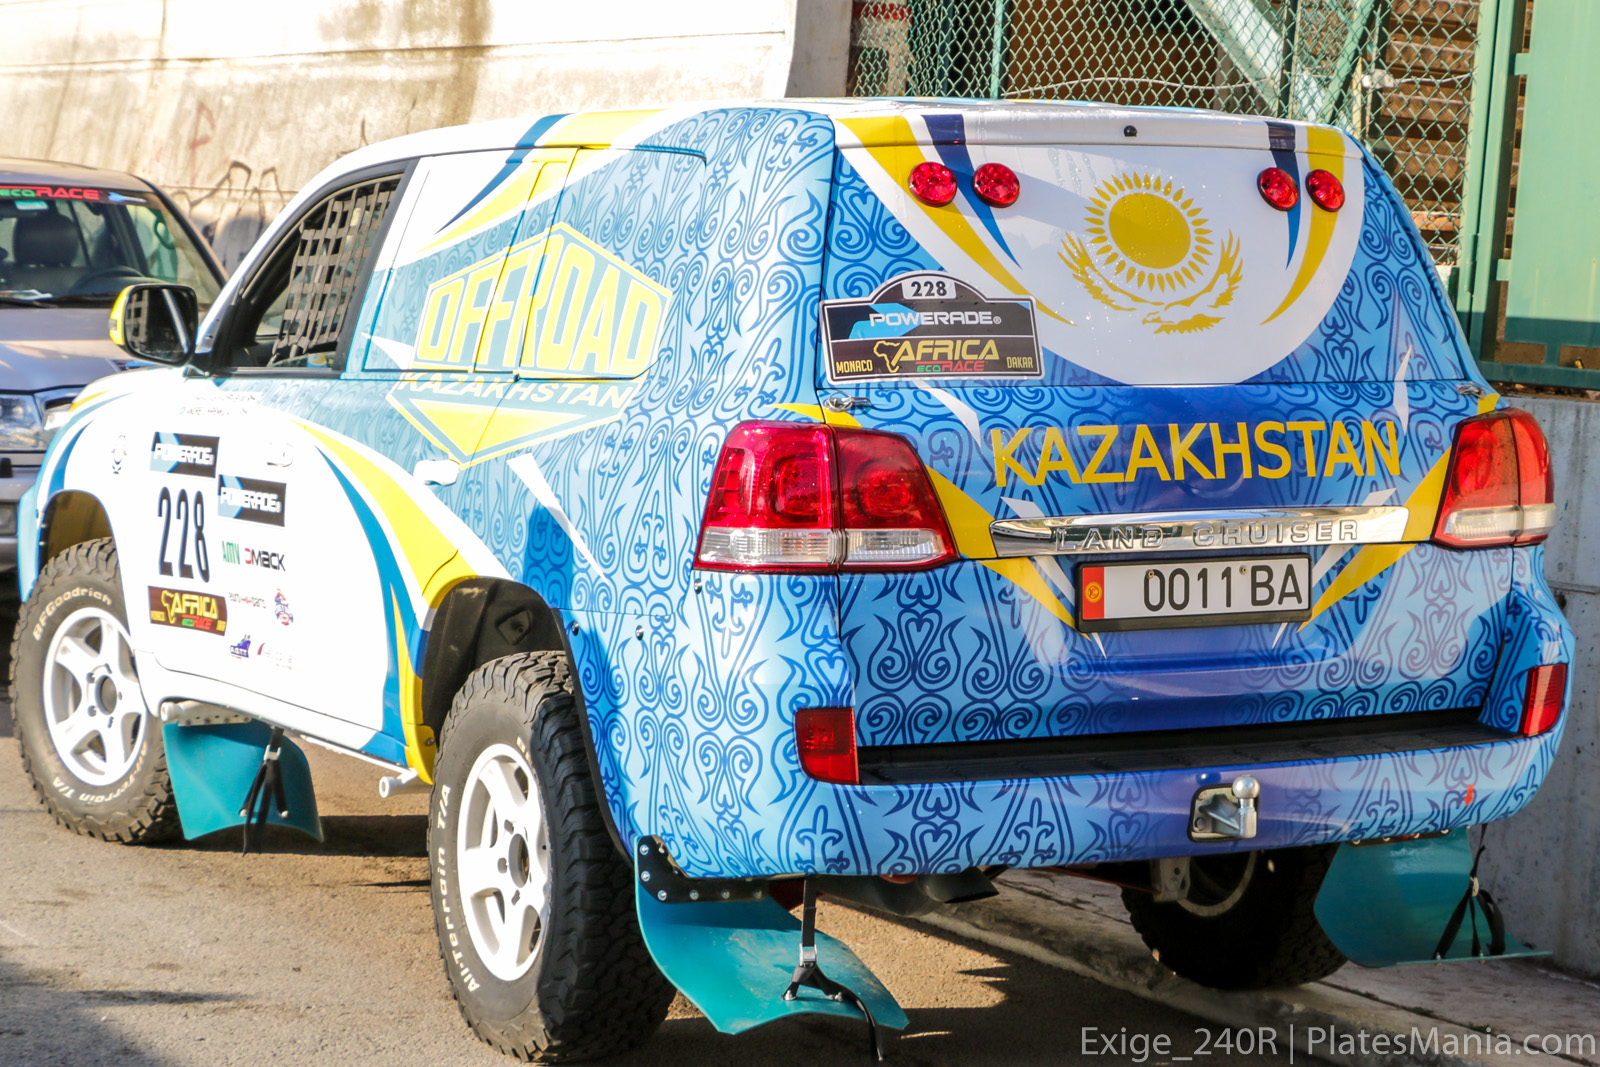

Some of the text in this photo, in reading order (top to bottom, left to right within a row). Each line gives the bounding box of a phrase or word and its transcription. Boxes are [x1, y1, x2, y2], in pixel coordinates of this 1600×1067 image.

[416, 234, 663, 375] OFFROAD
[911, 281, 947, 297] 228
[836, 360, 873, 374] MONACO
[1006, 357, 1034, 369] DAKAR
[890, 339, 1000, 367] AFRICA
[398, 371, 633, 409] KAZAKHSTAN
[989, 420, 1401, 488] KAZAKHSTAN
[157, 486, 210, 583] 228
[1055, 518, 1359, 552] LAND CRUISER
[170, 592, 219, 620] AFRICA
[1143, 563, 1303, 612] 0011 BA
[33, 586, 113, 641] BFGoodrich
[437, 784, 451, 830] T/A
